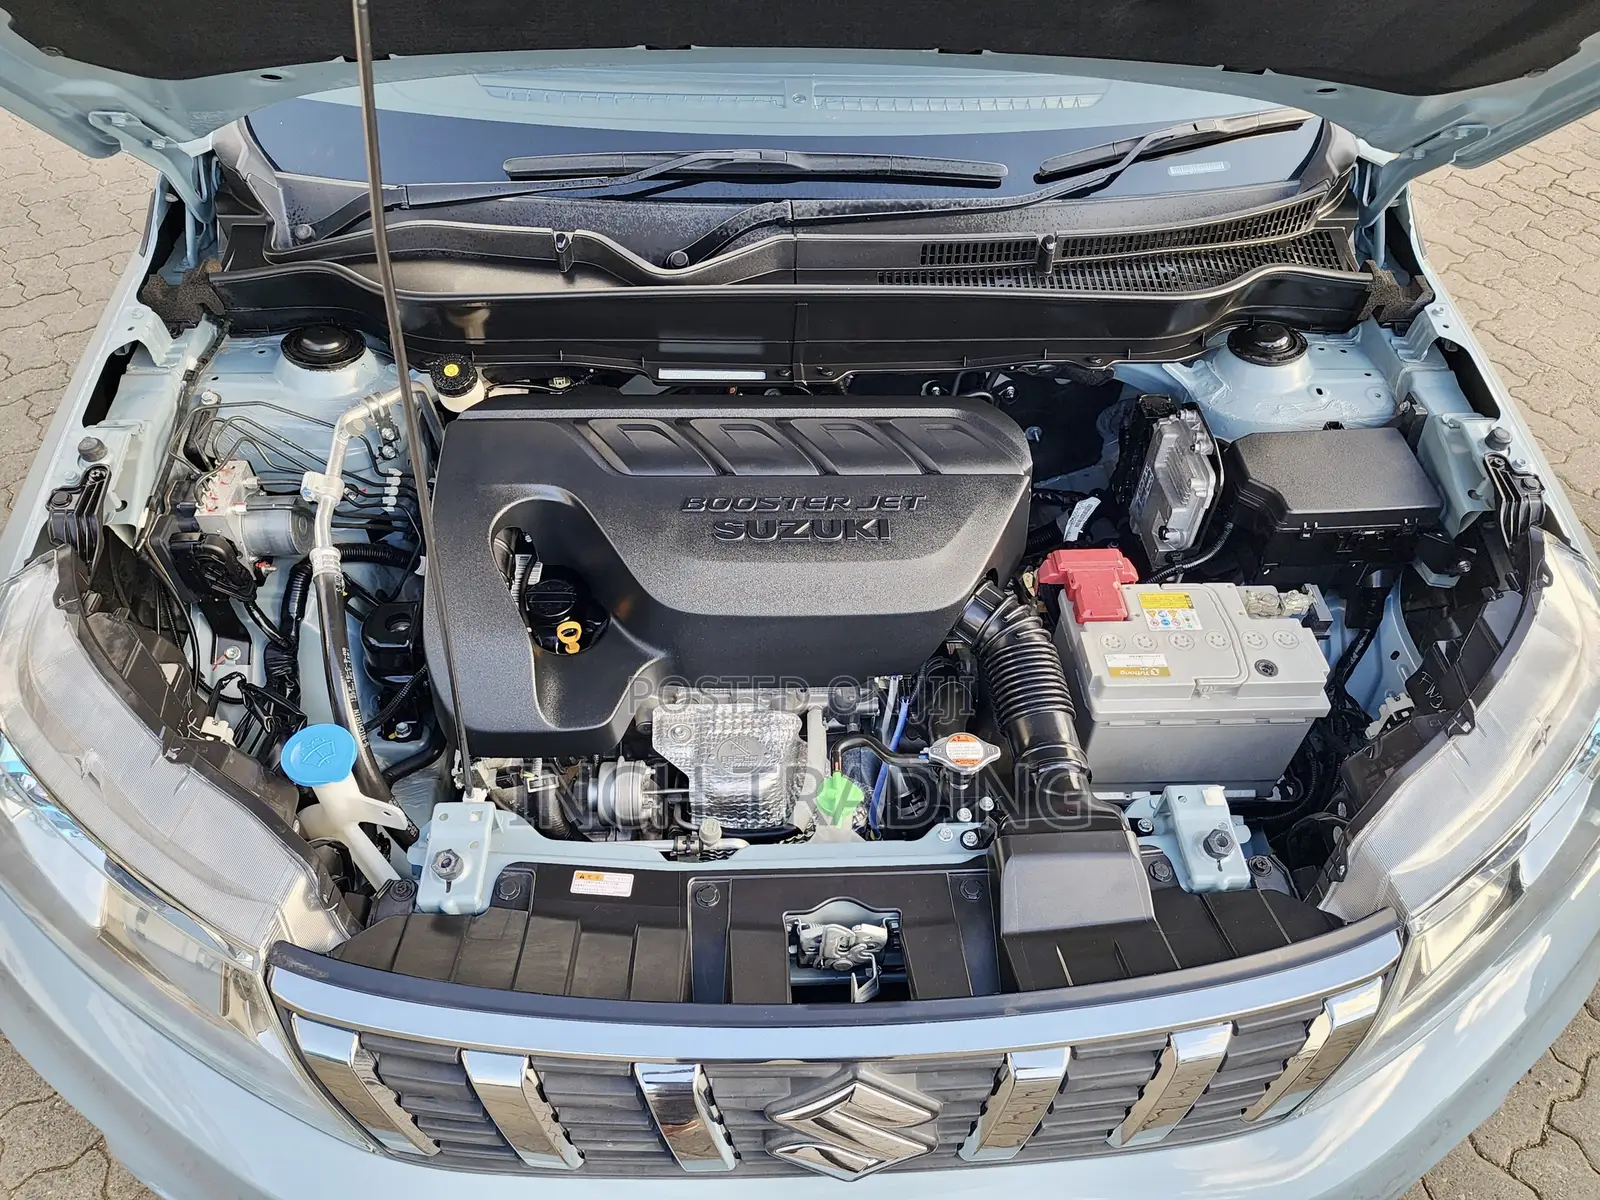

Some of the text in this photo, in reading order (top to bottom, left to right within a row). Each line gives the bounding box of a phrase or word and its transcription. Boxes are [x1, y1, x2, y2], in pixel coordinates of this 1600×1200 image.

[681, 494, 927, 512] BOOSTER JET
[713, 518, 892, 541] SUZUKI
